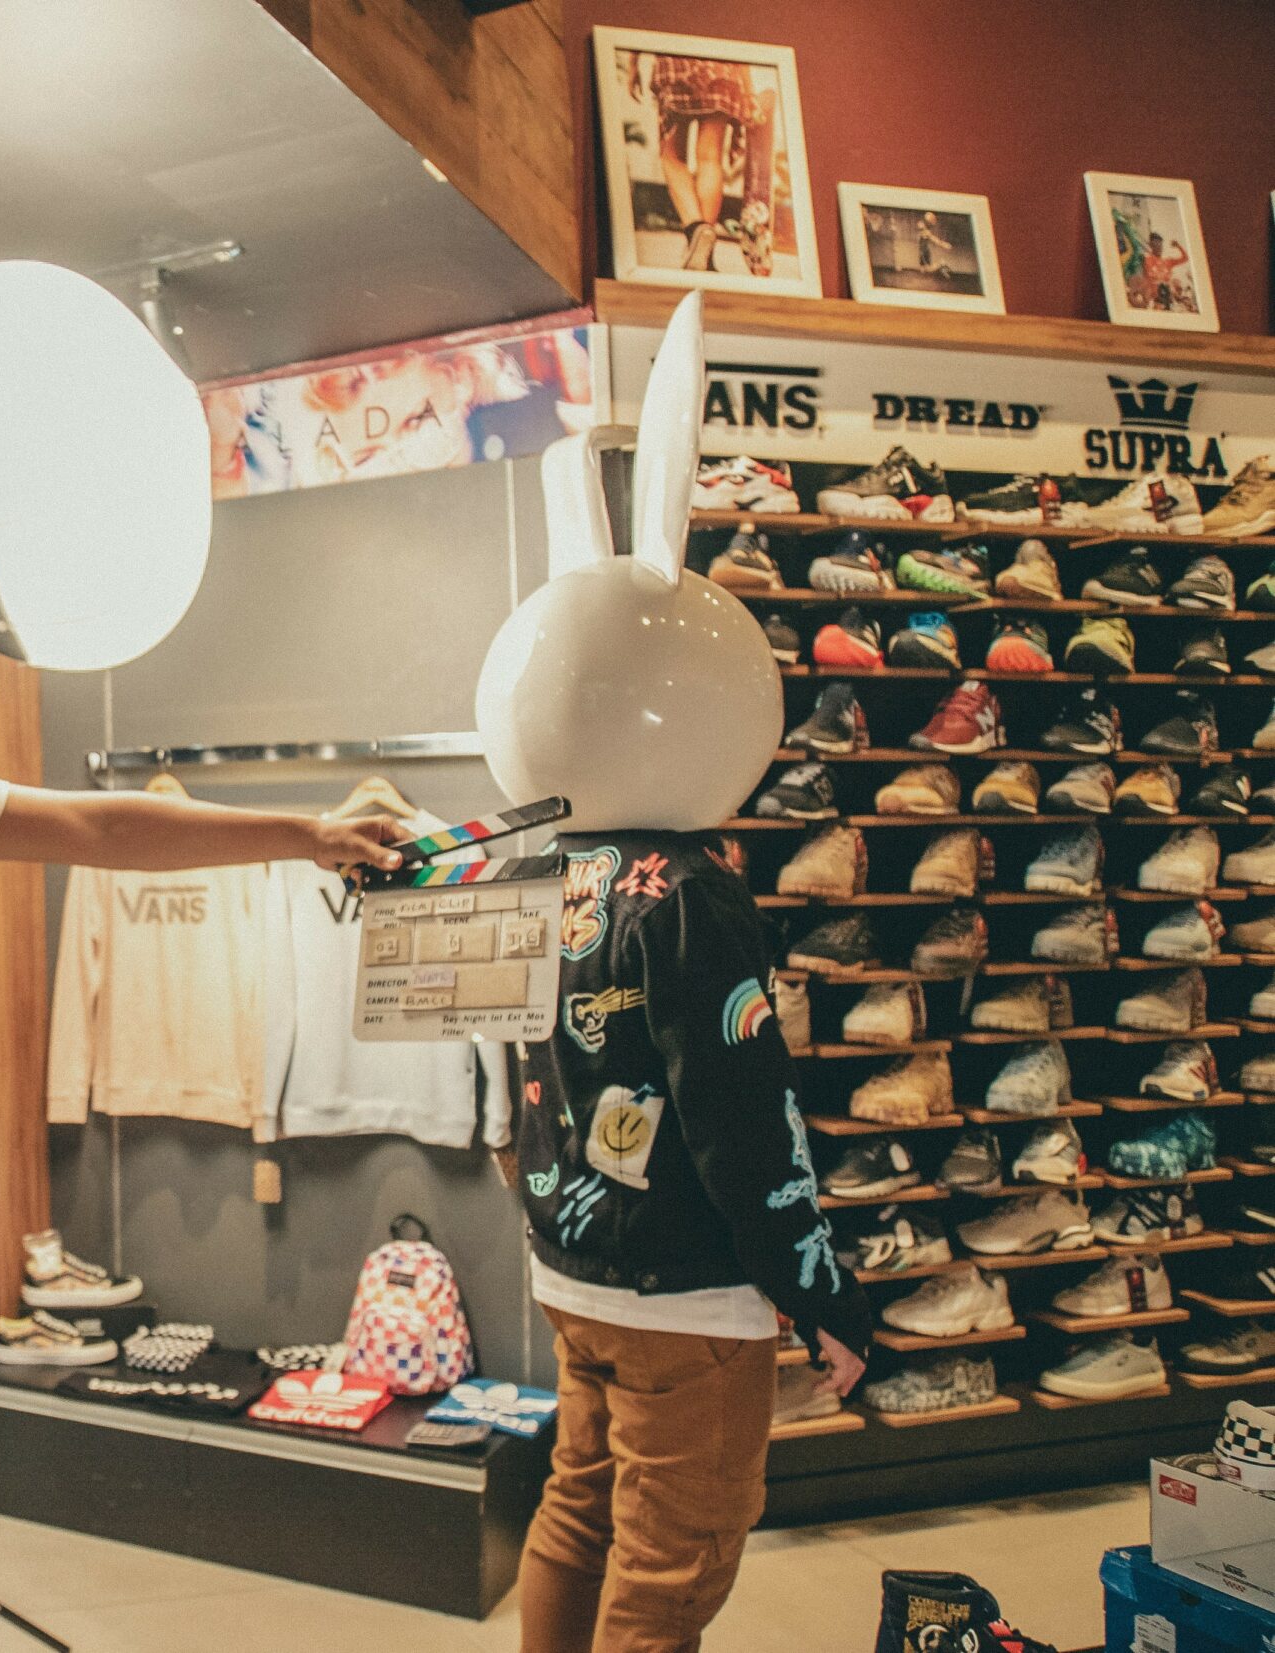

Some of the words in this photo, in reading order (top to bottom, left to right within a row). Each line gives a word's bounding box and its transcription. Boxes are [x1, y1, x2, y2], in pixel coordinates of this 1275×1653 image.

[703, 361, 822, 431] ANS
[873, 393, 1040, 431] DREAD
[1085, 429, 1228, 477] SUPRA
[118, 885, 208, 924] VANS
[518, 910, 540, 919] TAKE
[443, 916, 471, 925] SCENE
[367, 979, 408, 989] DIRECTOR
[366, 997, 400, 1006] CAMERA
[365, 1016, 384, 1024] DATE
[443, 1015, 459, 1024] Day
[464, 1014, 486, 1024] Night
[508, 1013, 522, 1021] Ext
[442, 1028, 465, 1036] Filter
[523, 1025, 543, 1035] Sync
